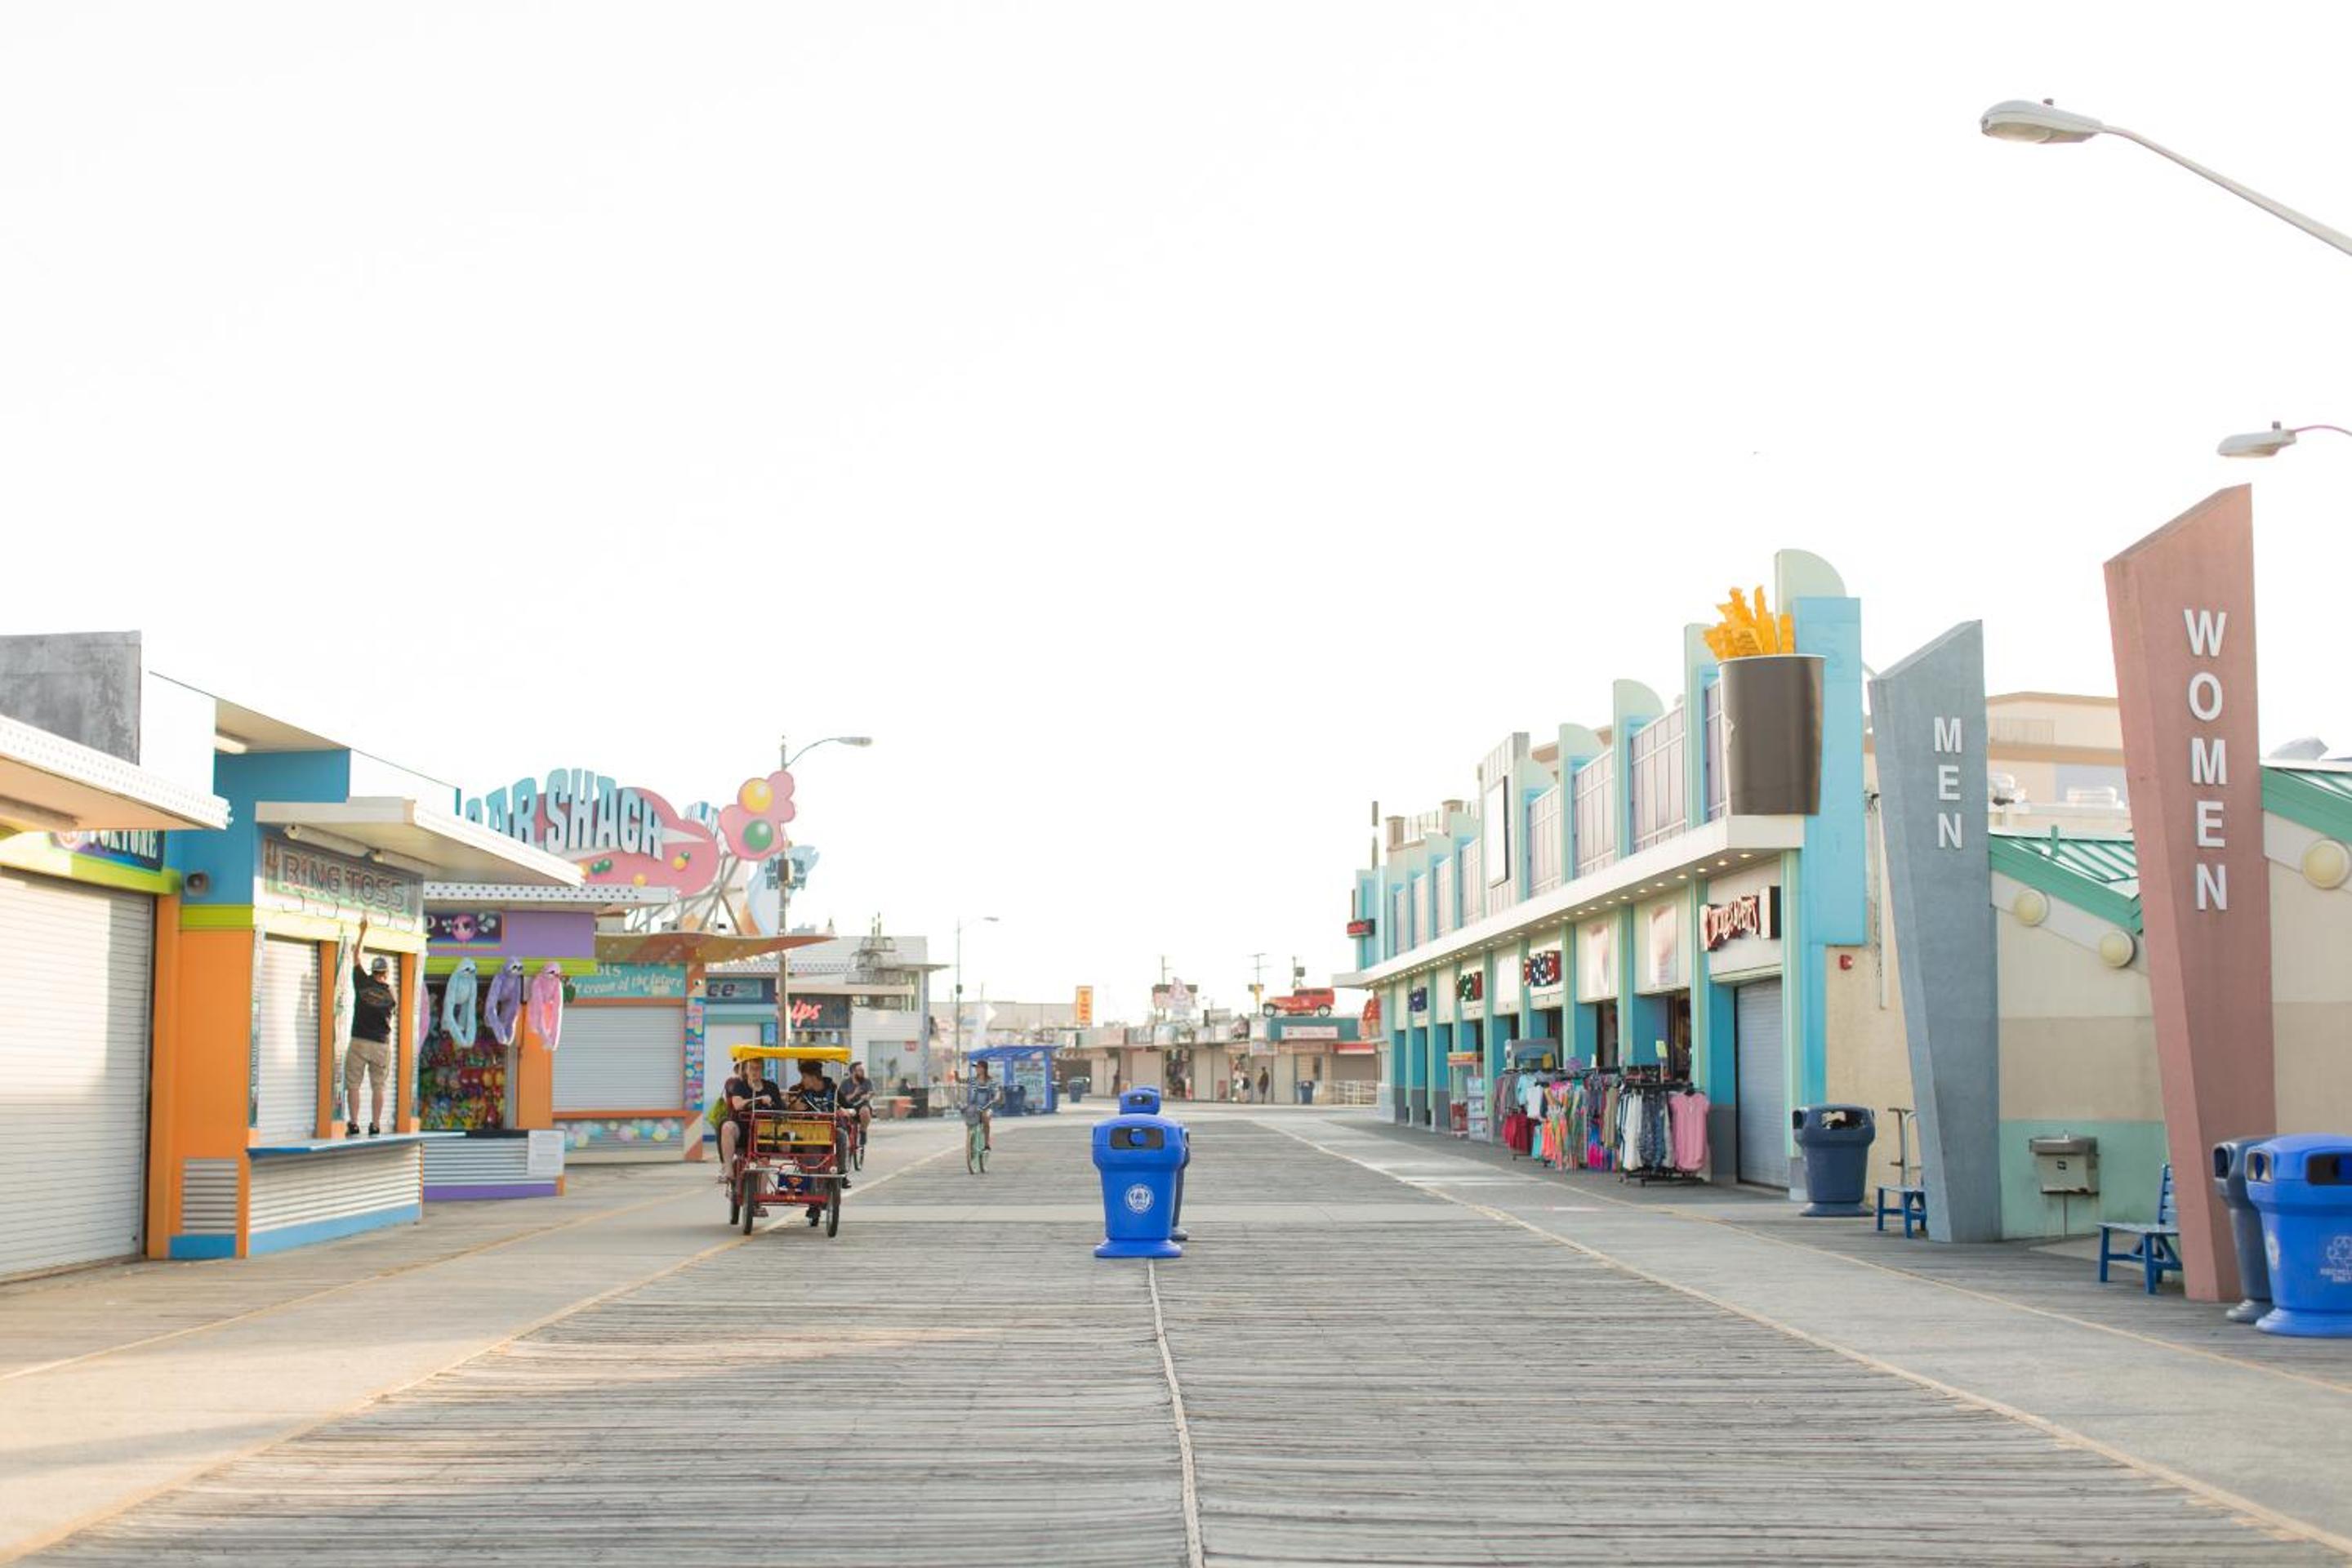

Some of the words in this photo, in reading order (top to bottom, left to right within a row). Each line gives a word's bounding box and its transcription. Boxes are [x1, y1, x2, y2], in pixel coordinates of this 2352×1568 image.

[546, 768, 663, 862] SHACK
[1934, 716, 1962, 849] MEN
[2183, 608, 2228, 911] WOMEN
[282, 851, 341, 898] RING
[344, 863, 408, 914] TOSS
